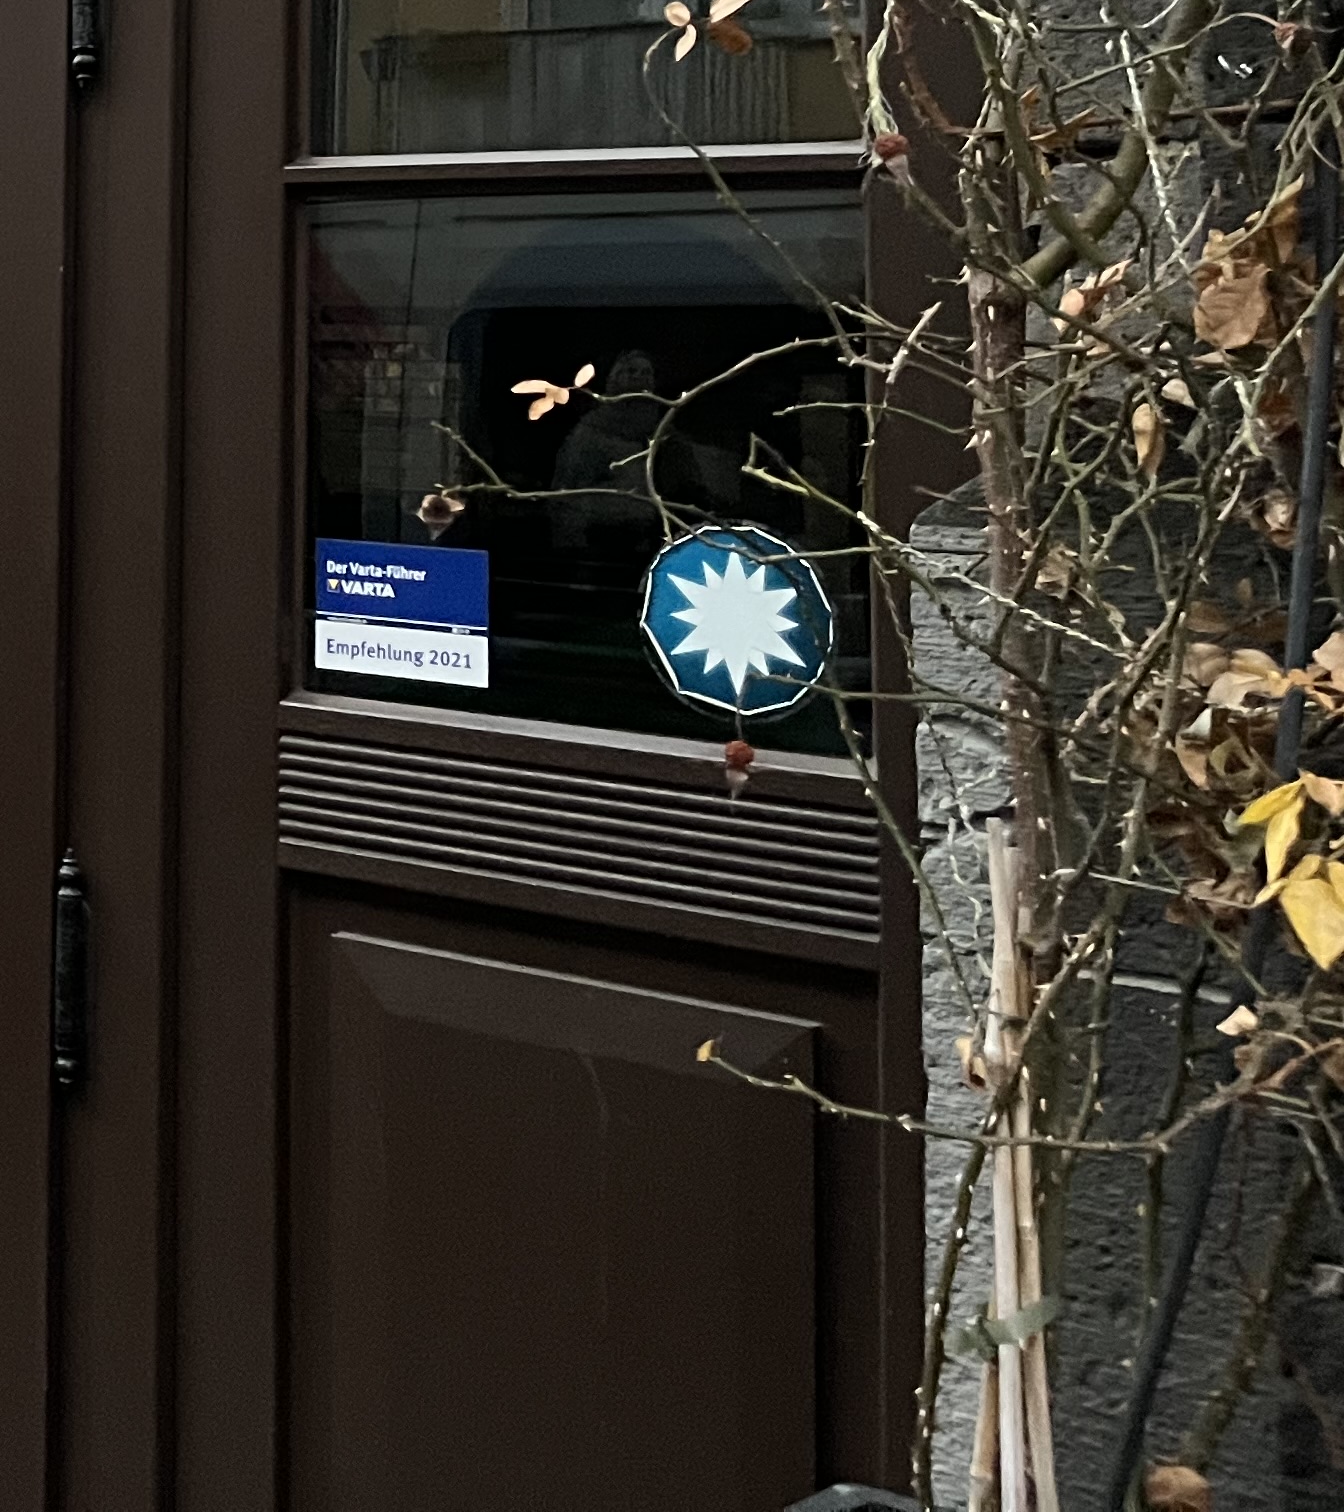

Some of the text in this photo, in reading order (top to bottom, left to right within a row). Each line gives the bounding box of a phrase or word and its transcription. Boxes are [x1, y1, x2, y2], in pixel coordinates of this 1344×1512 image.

[326, 560, 427, 581] Der Varta-Führer
[340, 578, 396, 599] VARTA
[326, 638, 472, 670] Empfehlung 2021
